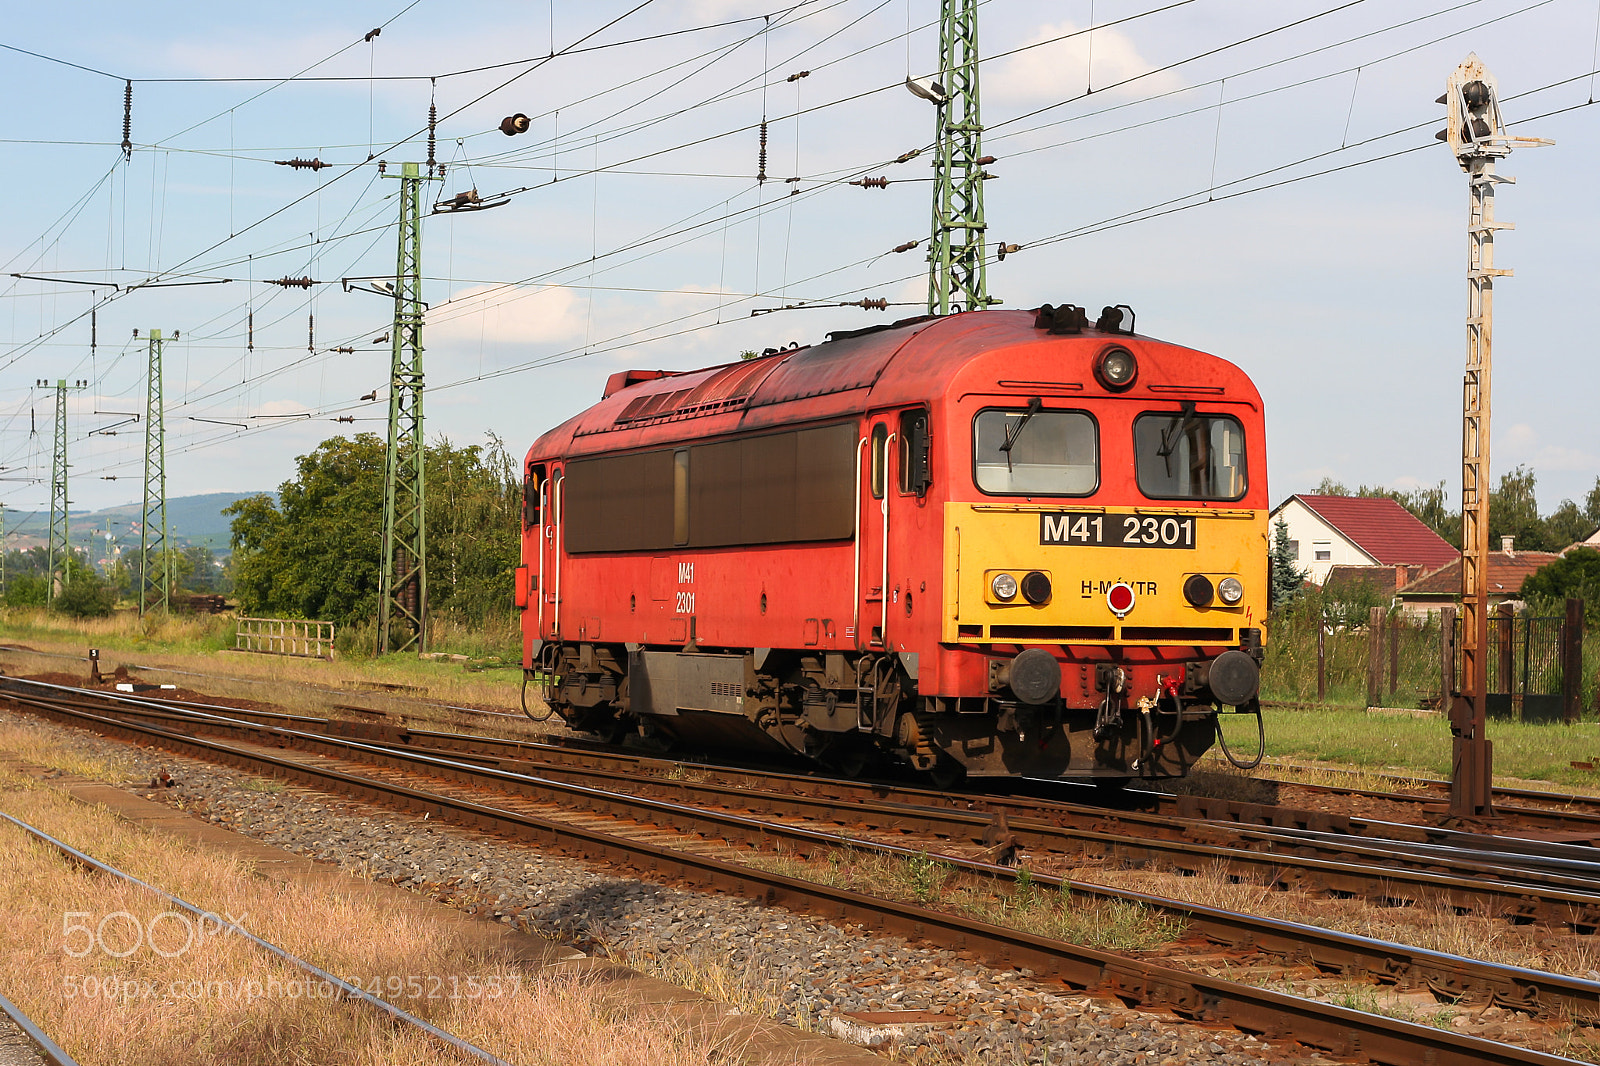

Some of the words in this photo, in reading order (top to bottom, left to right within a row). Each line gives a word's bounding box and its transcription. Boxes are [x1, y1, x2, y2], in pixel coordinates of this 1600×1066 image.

[1044, 515, 1103, 543] M41
[1123, 516, 1192, 545] 2301
[678, 562, 694, 584] M41
[1081, 577, 1158, 598] H-MTR
[676, 591, 695, 614] 2301
